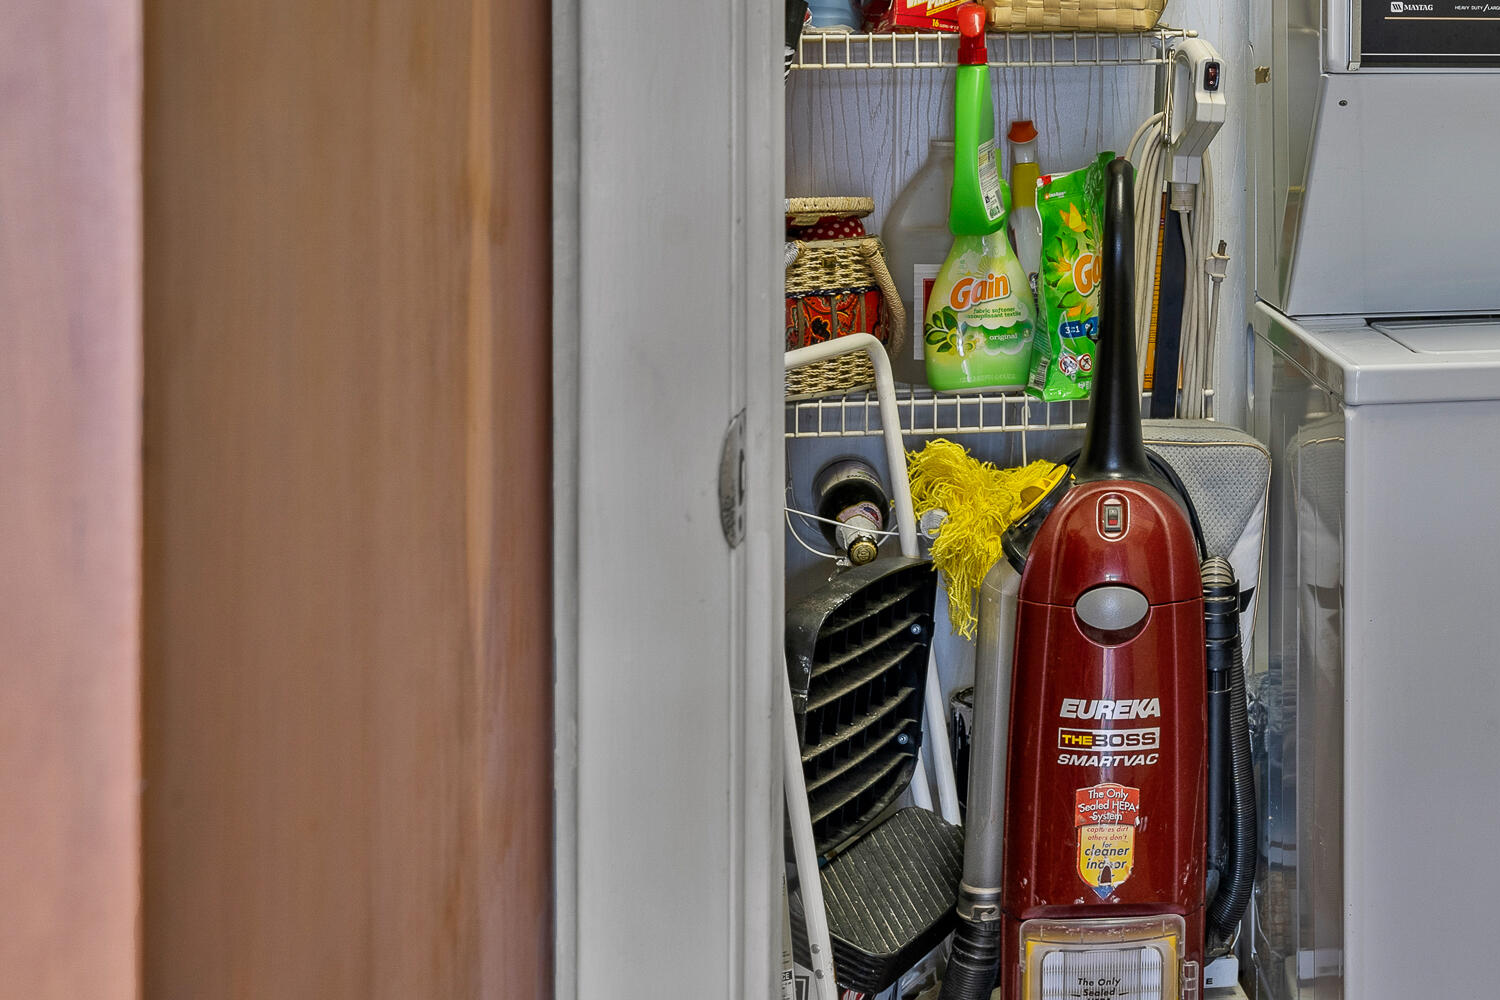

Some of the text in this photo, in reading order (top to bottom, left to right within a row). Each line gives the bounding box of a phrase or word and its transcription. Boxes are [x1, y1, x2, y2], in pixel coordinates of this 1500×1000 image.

[932, 18, 939, 27] 16
[1074, 254, 1101, 296] Ga
[949, 272, 1010, 311] Gain
[989, 333, 1018, 341] original
[1060, 698, 1160, 720] EUREKA
[1062, 732, 1156, 747] THE BOSS
[1057, 753, 1159, 767] SMARTVAC
[1088, 788, 1129, 801] The Only
[1080, 800, 1136, 813] Sealed HEPA
[1092, 811, 1123, 824] System
[1086, 826, 1115, 834] captes
[1109, 833, 1128, 841] don't
[1085, 844, 1130, 857] cleaner
[1086, 858, 1127, 870] indor
[1077, 977, 1121, 987] The Only
[1083, 988, 1116, 997] Sealed
